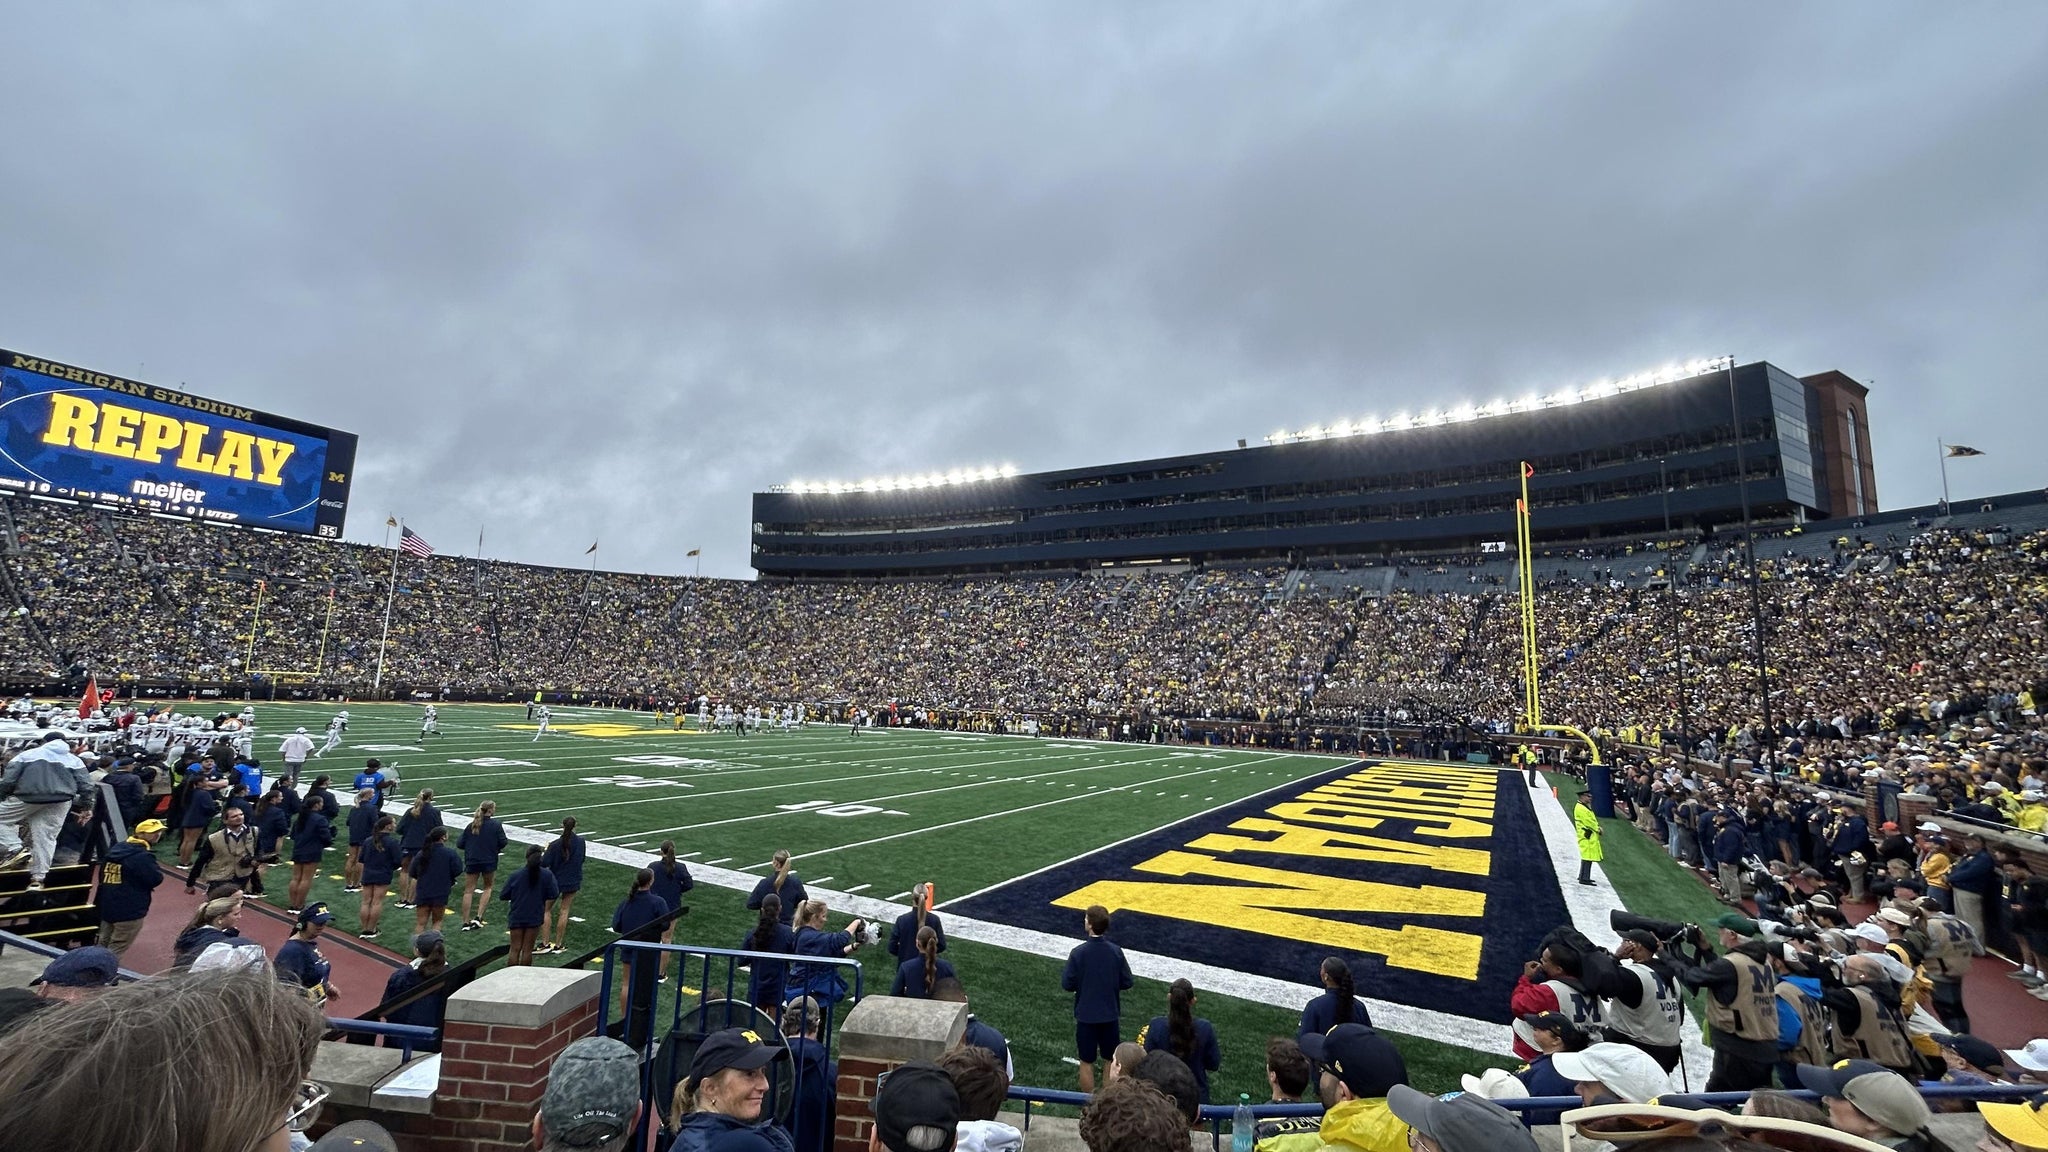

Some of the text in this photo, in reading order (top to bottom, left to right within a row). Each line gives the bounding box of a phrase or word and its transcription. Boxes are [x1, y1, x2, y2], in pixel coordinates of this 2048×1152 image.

[12, 355, 253, 421] MICHIGAN STADIUM
[43, 392, 296, 486] REPLAY
[328, 471, 345, 483] M
[133, 480, 206, 504] meijer
[156, 729, 168, 739] 71
[193, 737, 211, 748] 77
[775, 800, 884, 817] 10
[1050, 762, 1498, 981] MICHIGAN
[1942, 921, 1973, 942] M
[1747, 965, 1775, 993] M
[1570, 993, 1602, 1023] M
[741, 1030, 762, 1044] M
